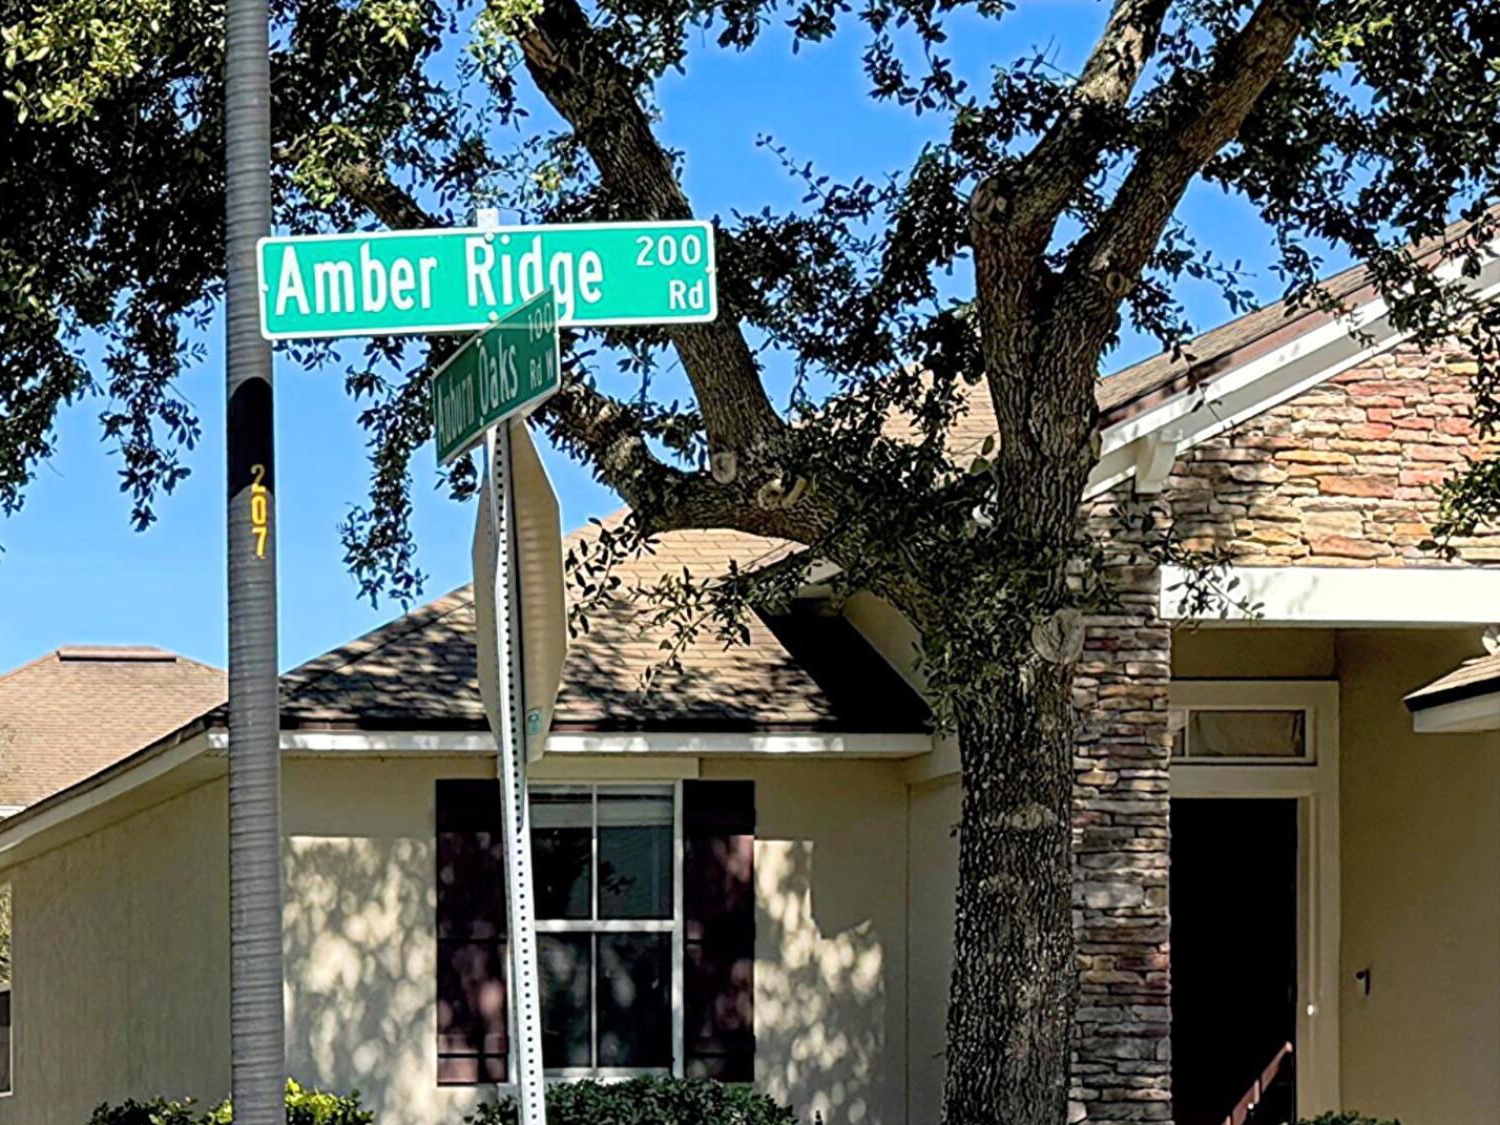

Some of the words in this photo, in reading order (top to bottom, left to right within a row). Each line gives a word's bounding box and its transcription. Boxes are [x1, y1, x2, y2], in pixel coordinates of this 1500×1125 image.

[636, 235, 702, 268] 200
[275, 246, 437, 315] Amber
[466, 234, 604, 323] Ridge
[668, 279, 704, 311] Rd
[528, 302, 552, 343] 100
[438, 373, 475, 452] Auburn
[478, 335, 518, 416] Oaks
[529, 357, 543, 390] Rd
[251, 463, 267, 559] 207
